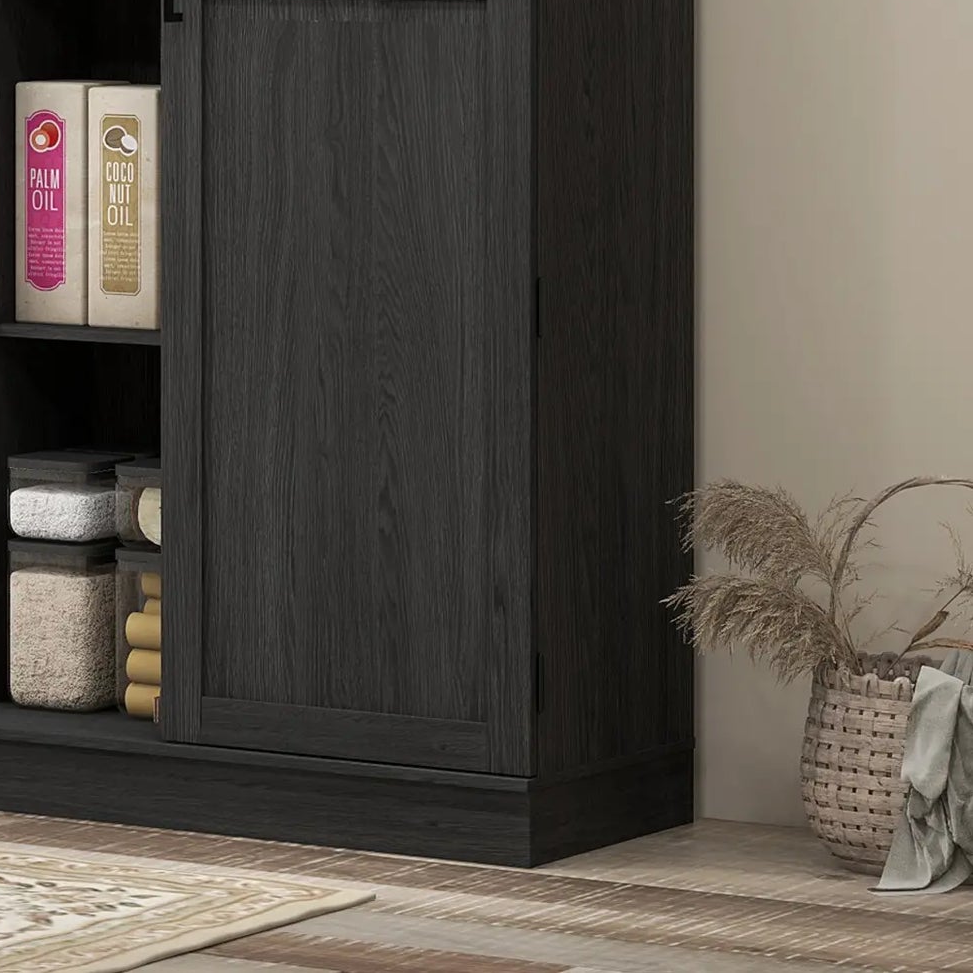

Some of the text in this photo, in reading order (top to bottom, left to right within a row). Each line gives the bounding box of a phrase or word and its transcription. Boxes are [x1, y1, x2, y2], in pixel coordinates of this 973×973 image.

[30, 168, 60, 189] PALM
[106, 161, 134, 182] COCO
[32, 190, 59, 211] OIL
[109, 184, 131, 204] NUT
[107, 205, 133, 226] OIL
